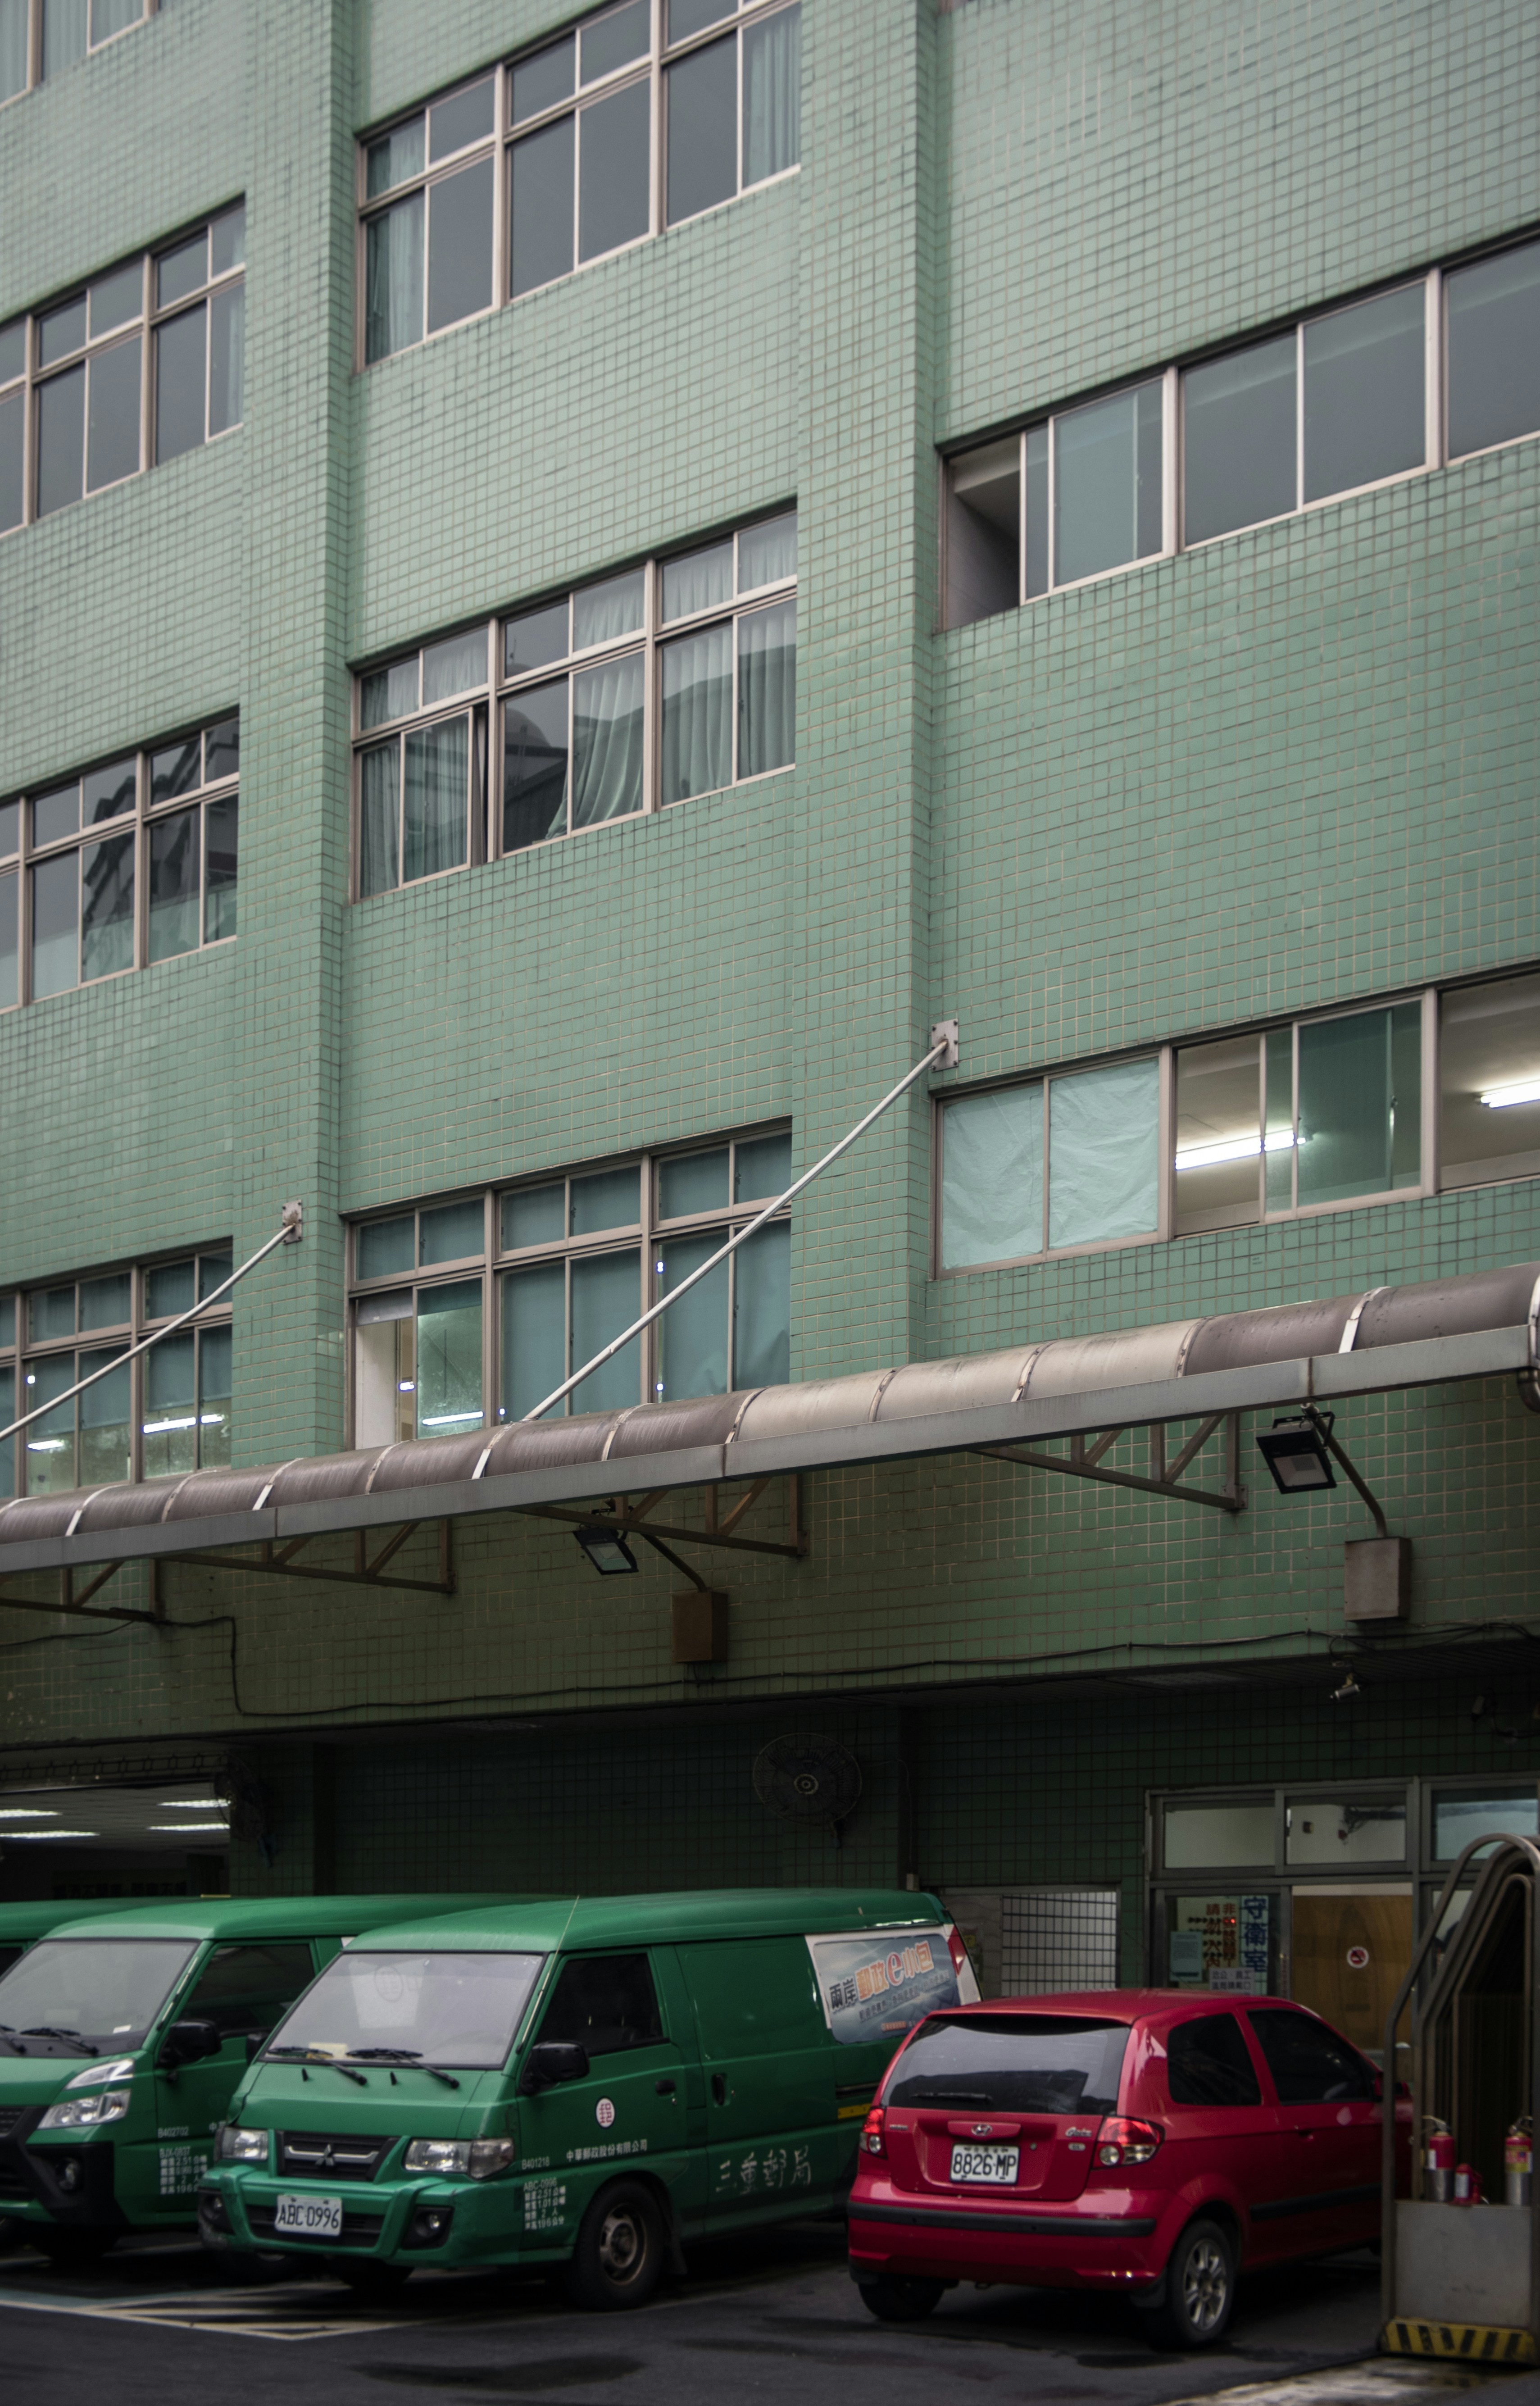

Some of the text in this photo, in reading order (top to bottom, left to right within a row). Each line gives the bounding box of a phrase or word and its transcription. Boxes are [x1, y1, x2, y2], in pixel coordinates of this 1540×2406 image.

[1245, 1897, 1267, 1972] 守衛室
[522, 2156, 550, 2169] B401218
[566, 2138, 647, 2162] 中華郵政股份有限公司
[716, 2145, 811, 2195] 三重郵局
